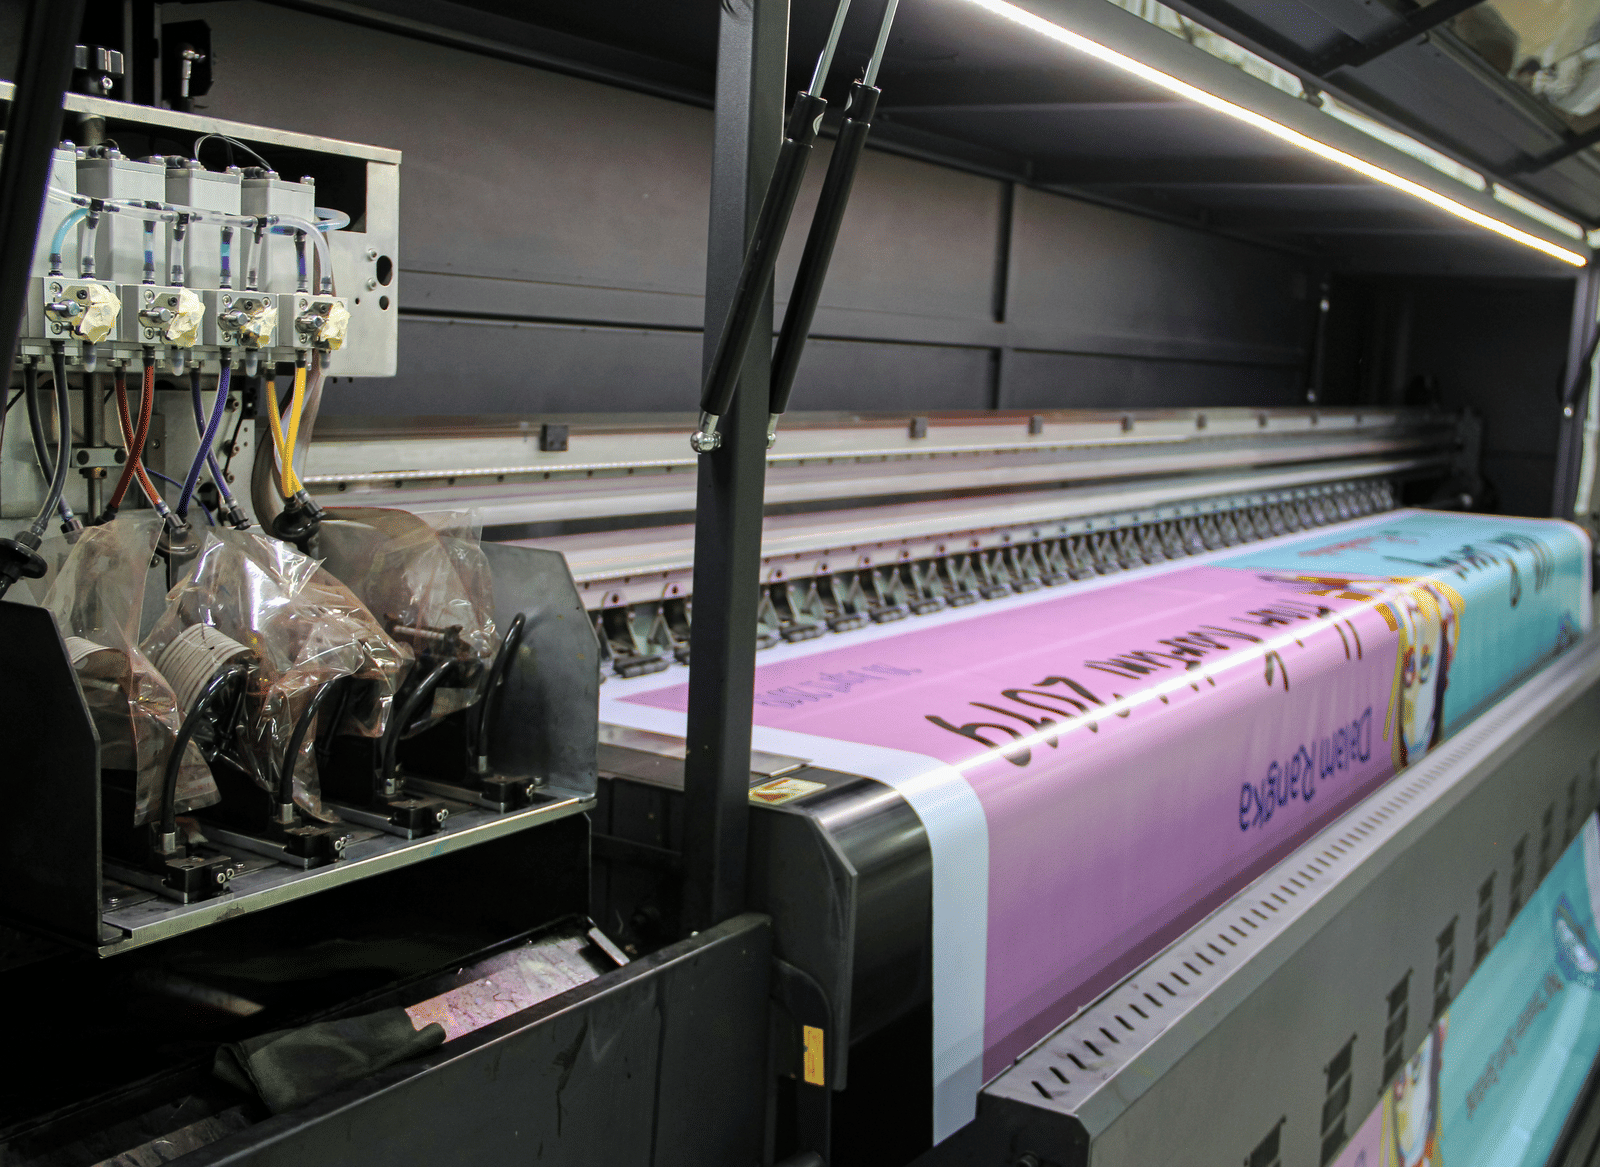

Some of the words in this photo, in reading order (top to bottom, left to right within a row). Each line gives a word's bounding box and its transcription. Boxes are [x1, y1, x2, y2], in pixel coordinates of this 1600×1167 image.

[924, 676, 1131, 767] 2019
[1319, 706, 1373, 781] Dalam
[1239, 744, 1317, 832] Rangka
